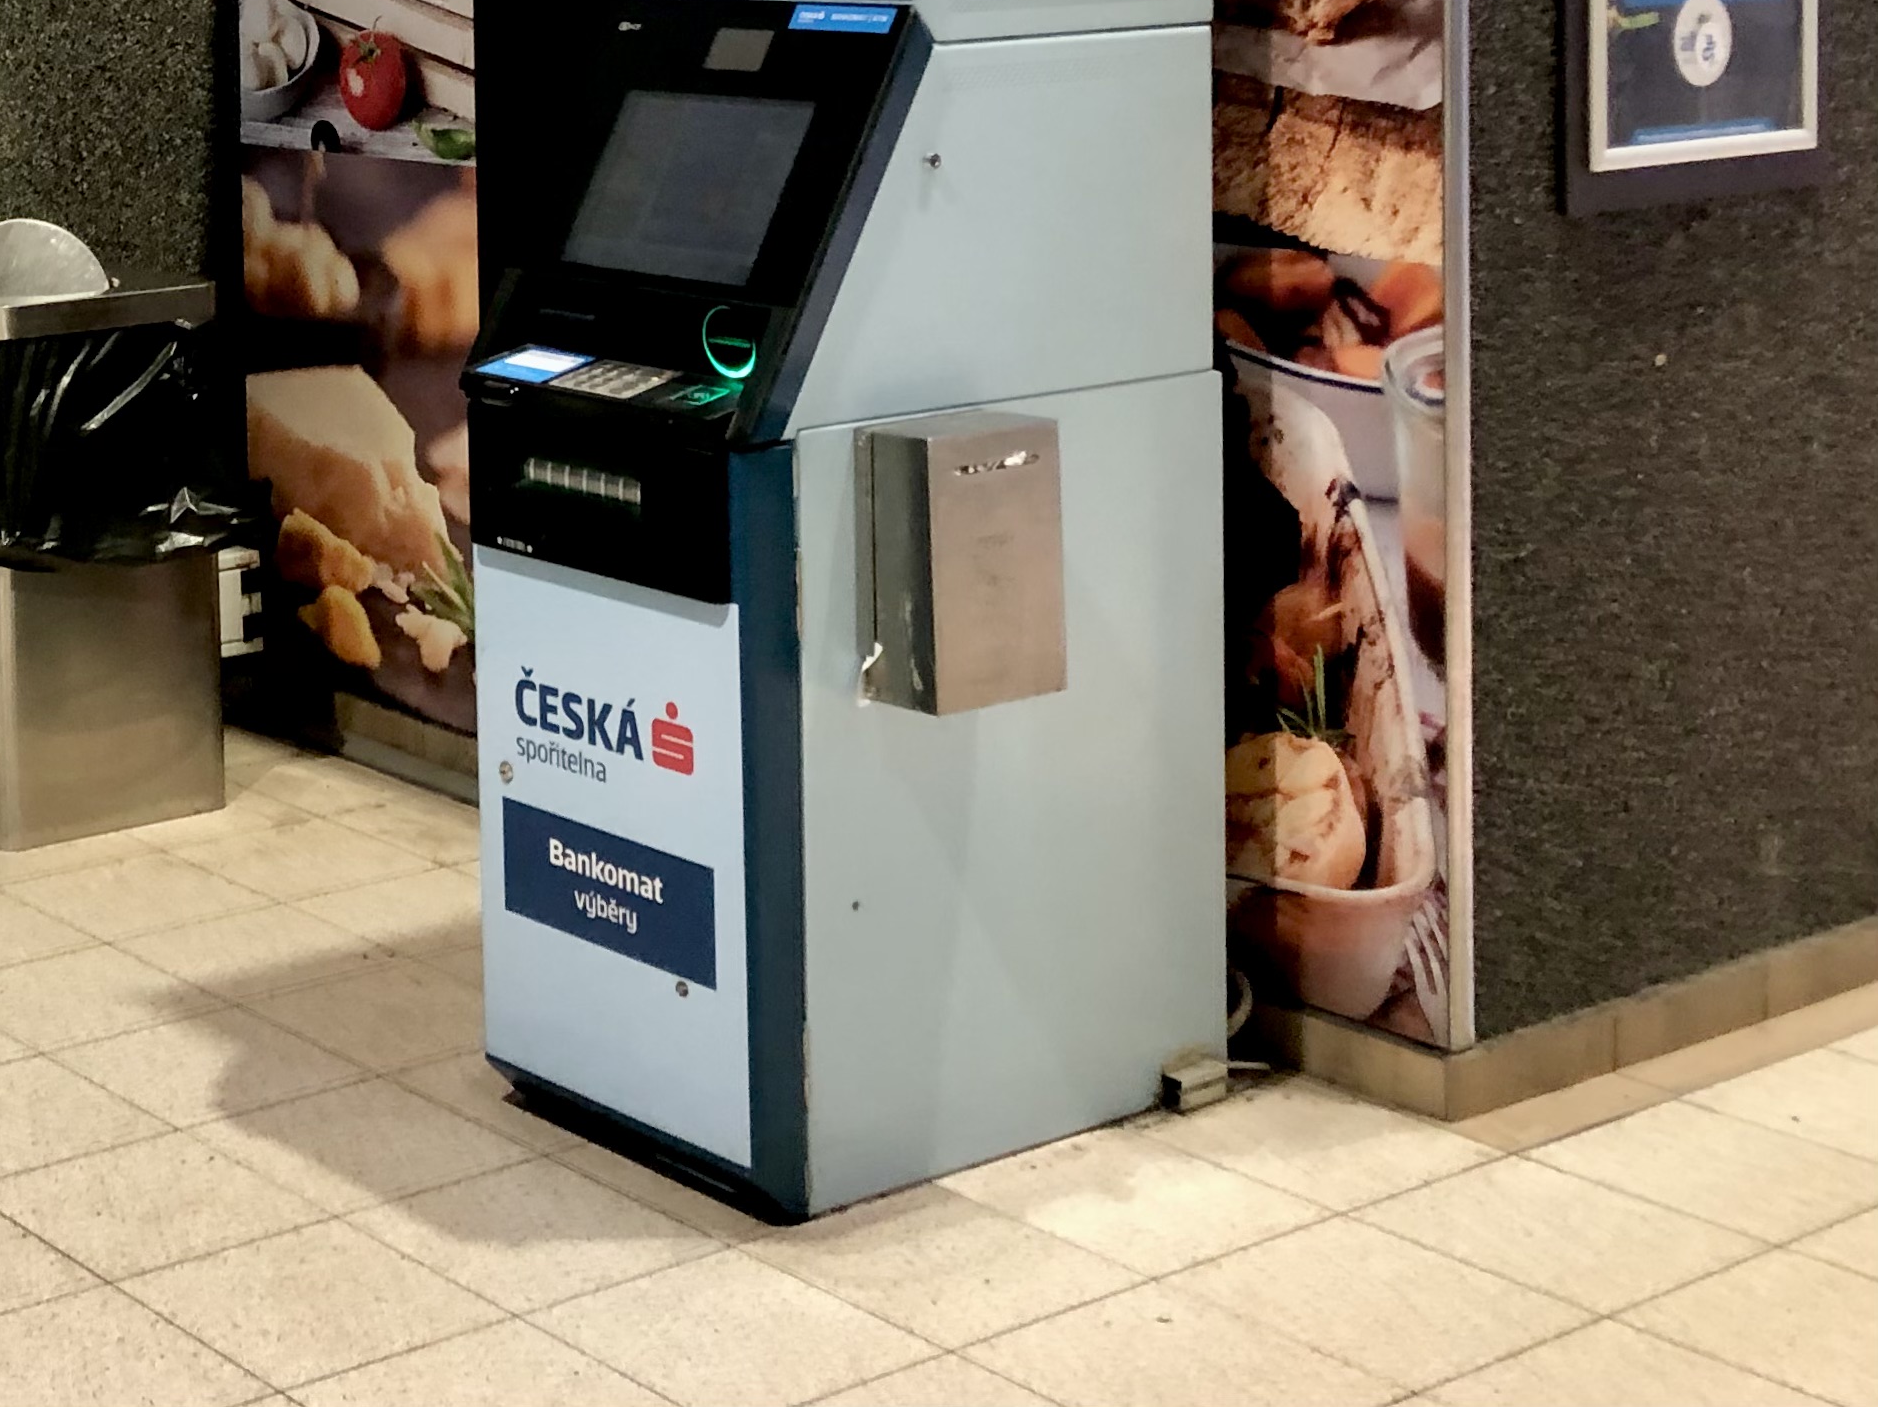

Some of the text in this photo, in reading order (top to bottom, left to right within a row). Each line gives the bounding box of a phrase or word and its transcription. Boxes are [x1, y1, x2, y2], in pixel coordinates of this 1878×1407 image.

[515, 665, 644, 761] ČESKÁ
[516, 736, 607, 783] spořitelna
[548, 836, 664, 905] Bankomat
[574, 889, 638, 935] výběry
